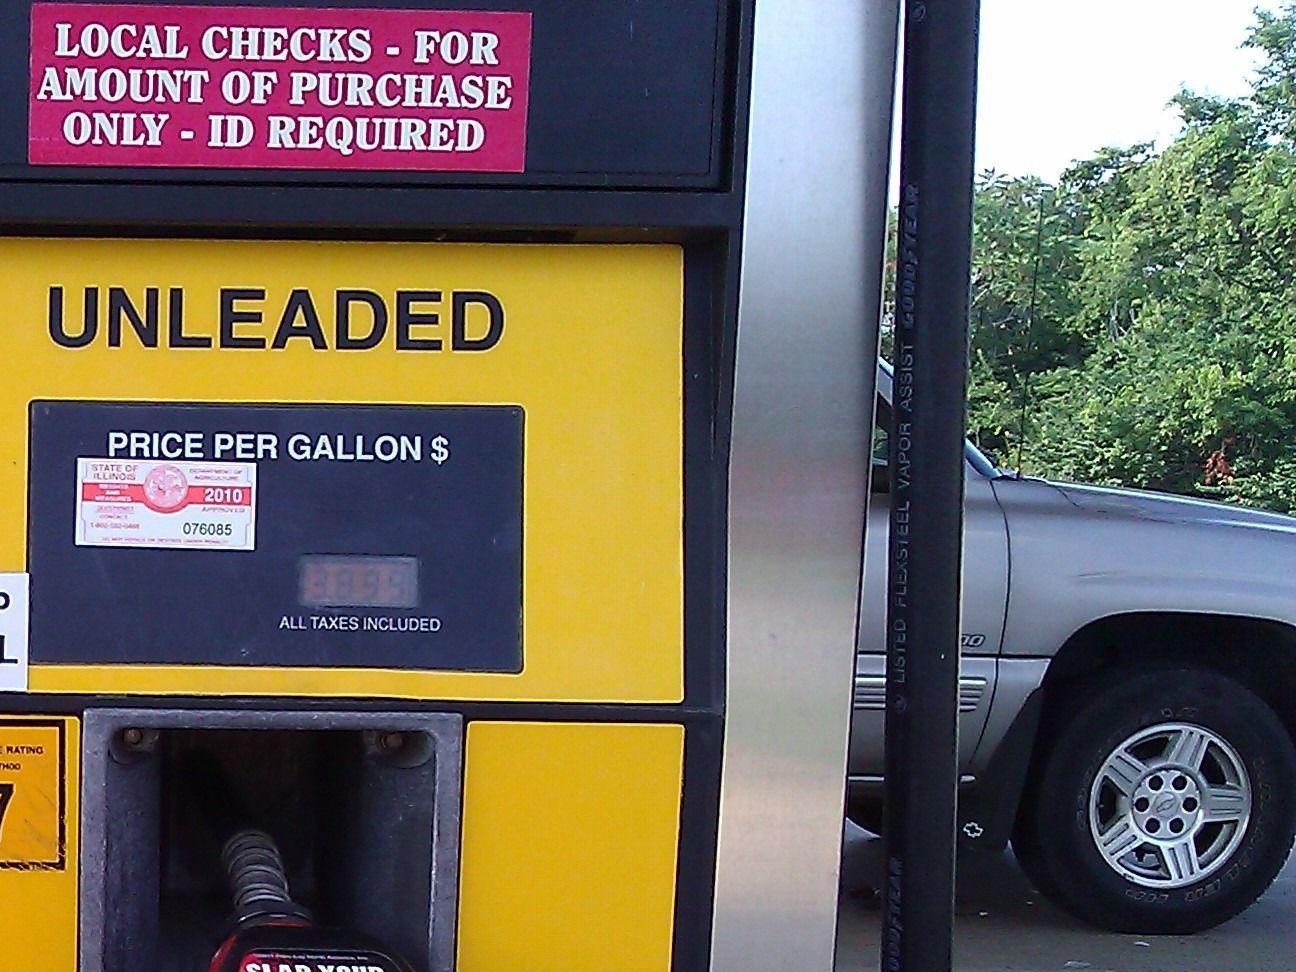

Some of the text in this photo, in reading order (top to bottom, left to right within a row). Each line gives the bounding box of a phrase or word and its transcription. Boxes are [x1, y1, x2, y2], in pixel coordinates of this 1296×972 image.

[55, 24, 188, 58] LOCAL
[202, 27, 371, 62] CHECKS
[414, 31, 498, 64] FOR
[37, 67, 511, 109] AMOUNT OF PURCHASE
[64, 112, 169, 145] ONLY
[208, 115, 253, 146] ID
[267, 116, 484, 155] REQUIRED
[902, 184, 920, 331] GOODYEAR
[49, 287, 504, 351] UNLEADED
[898, 341, 915, 412] ASSIST
[92, 464, 122, 472] STATE
[108, 433, 448, 464] PRICE PER GALLON $
[896, 423, 913, 489] VAPOR
[204, 488, 243, 503] 2010
[183, 522, 232, 536] 076085
[893, 500, 910, 608] FLEXSTEEL
[280, 616, 440, 631] ALL TAXES INCLUDED
[893, 618, 907, 684] LISTED
[6, 745, 44, 754] RATING
